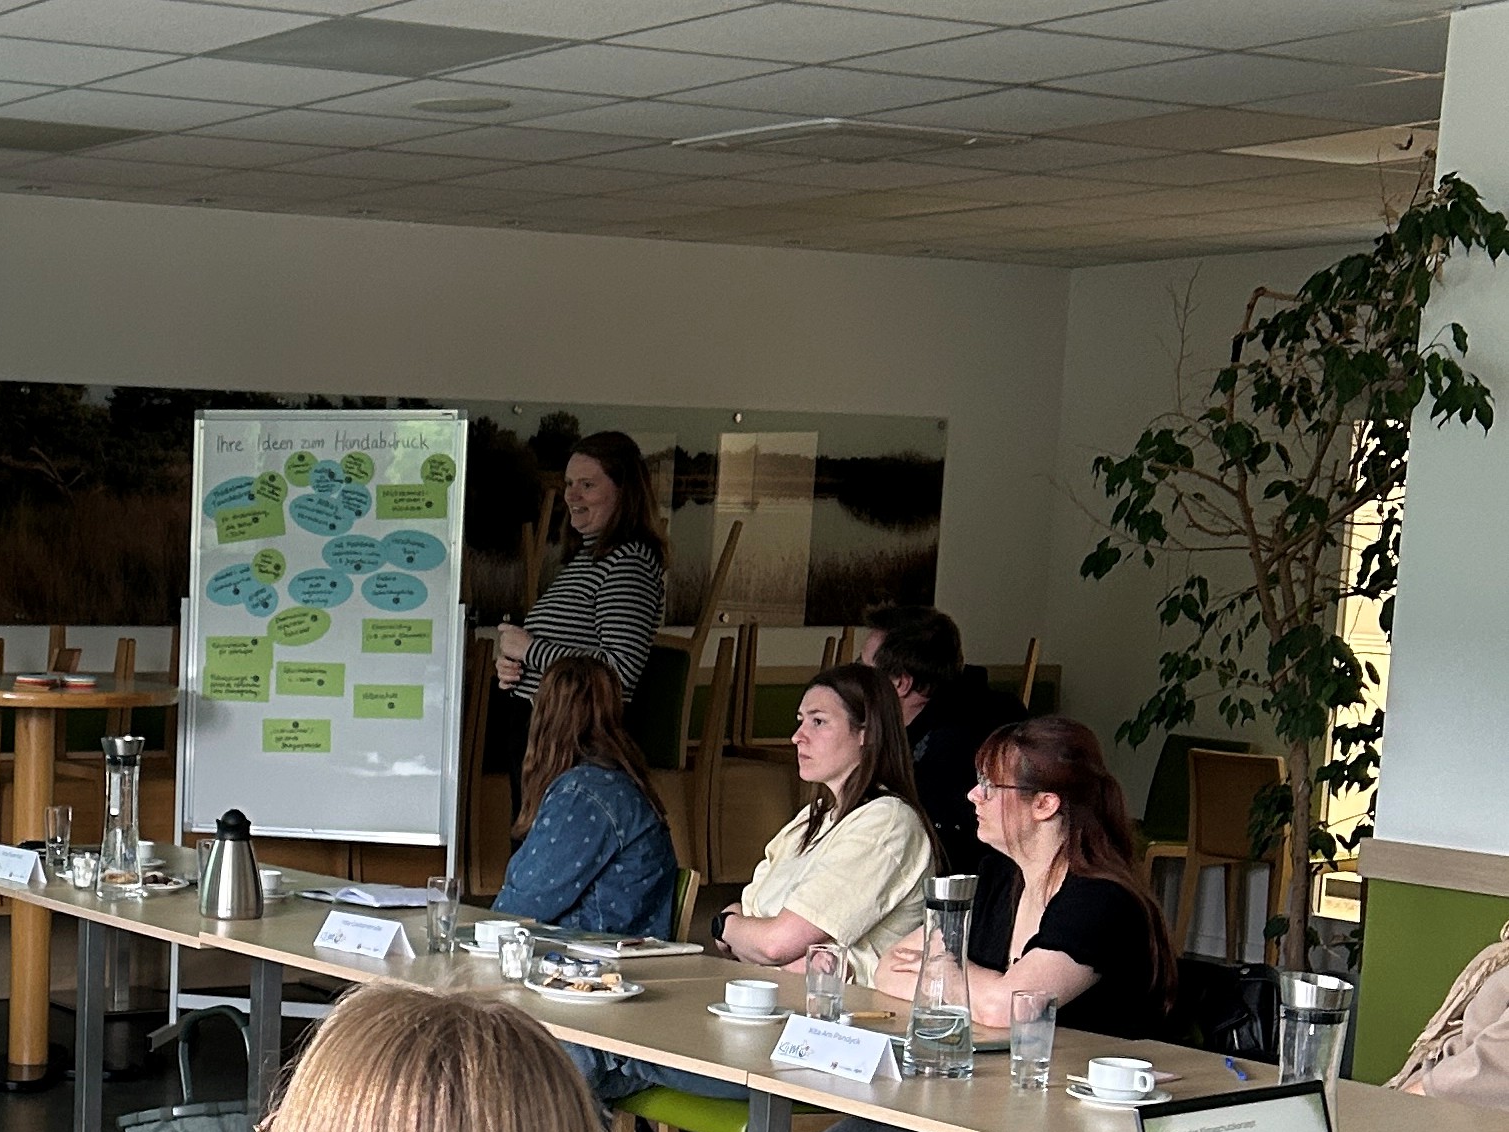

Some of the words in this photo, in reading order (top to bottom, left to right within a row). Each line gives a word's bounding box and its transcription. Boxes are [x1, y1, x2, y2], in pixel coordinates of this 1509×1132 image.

[216, 436, 244, 453] Ihre
[257, 433, 293, 451] Ideen
[300, 438, 325, 450] zum
[334, 430, 430, 451] Handabdruck
